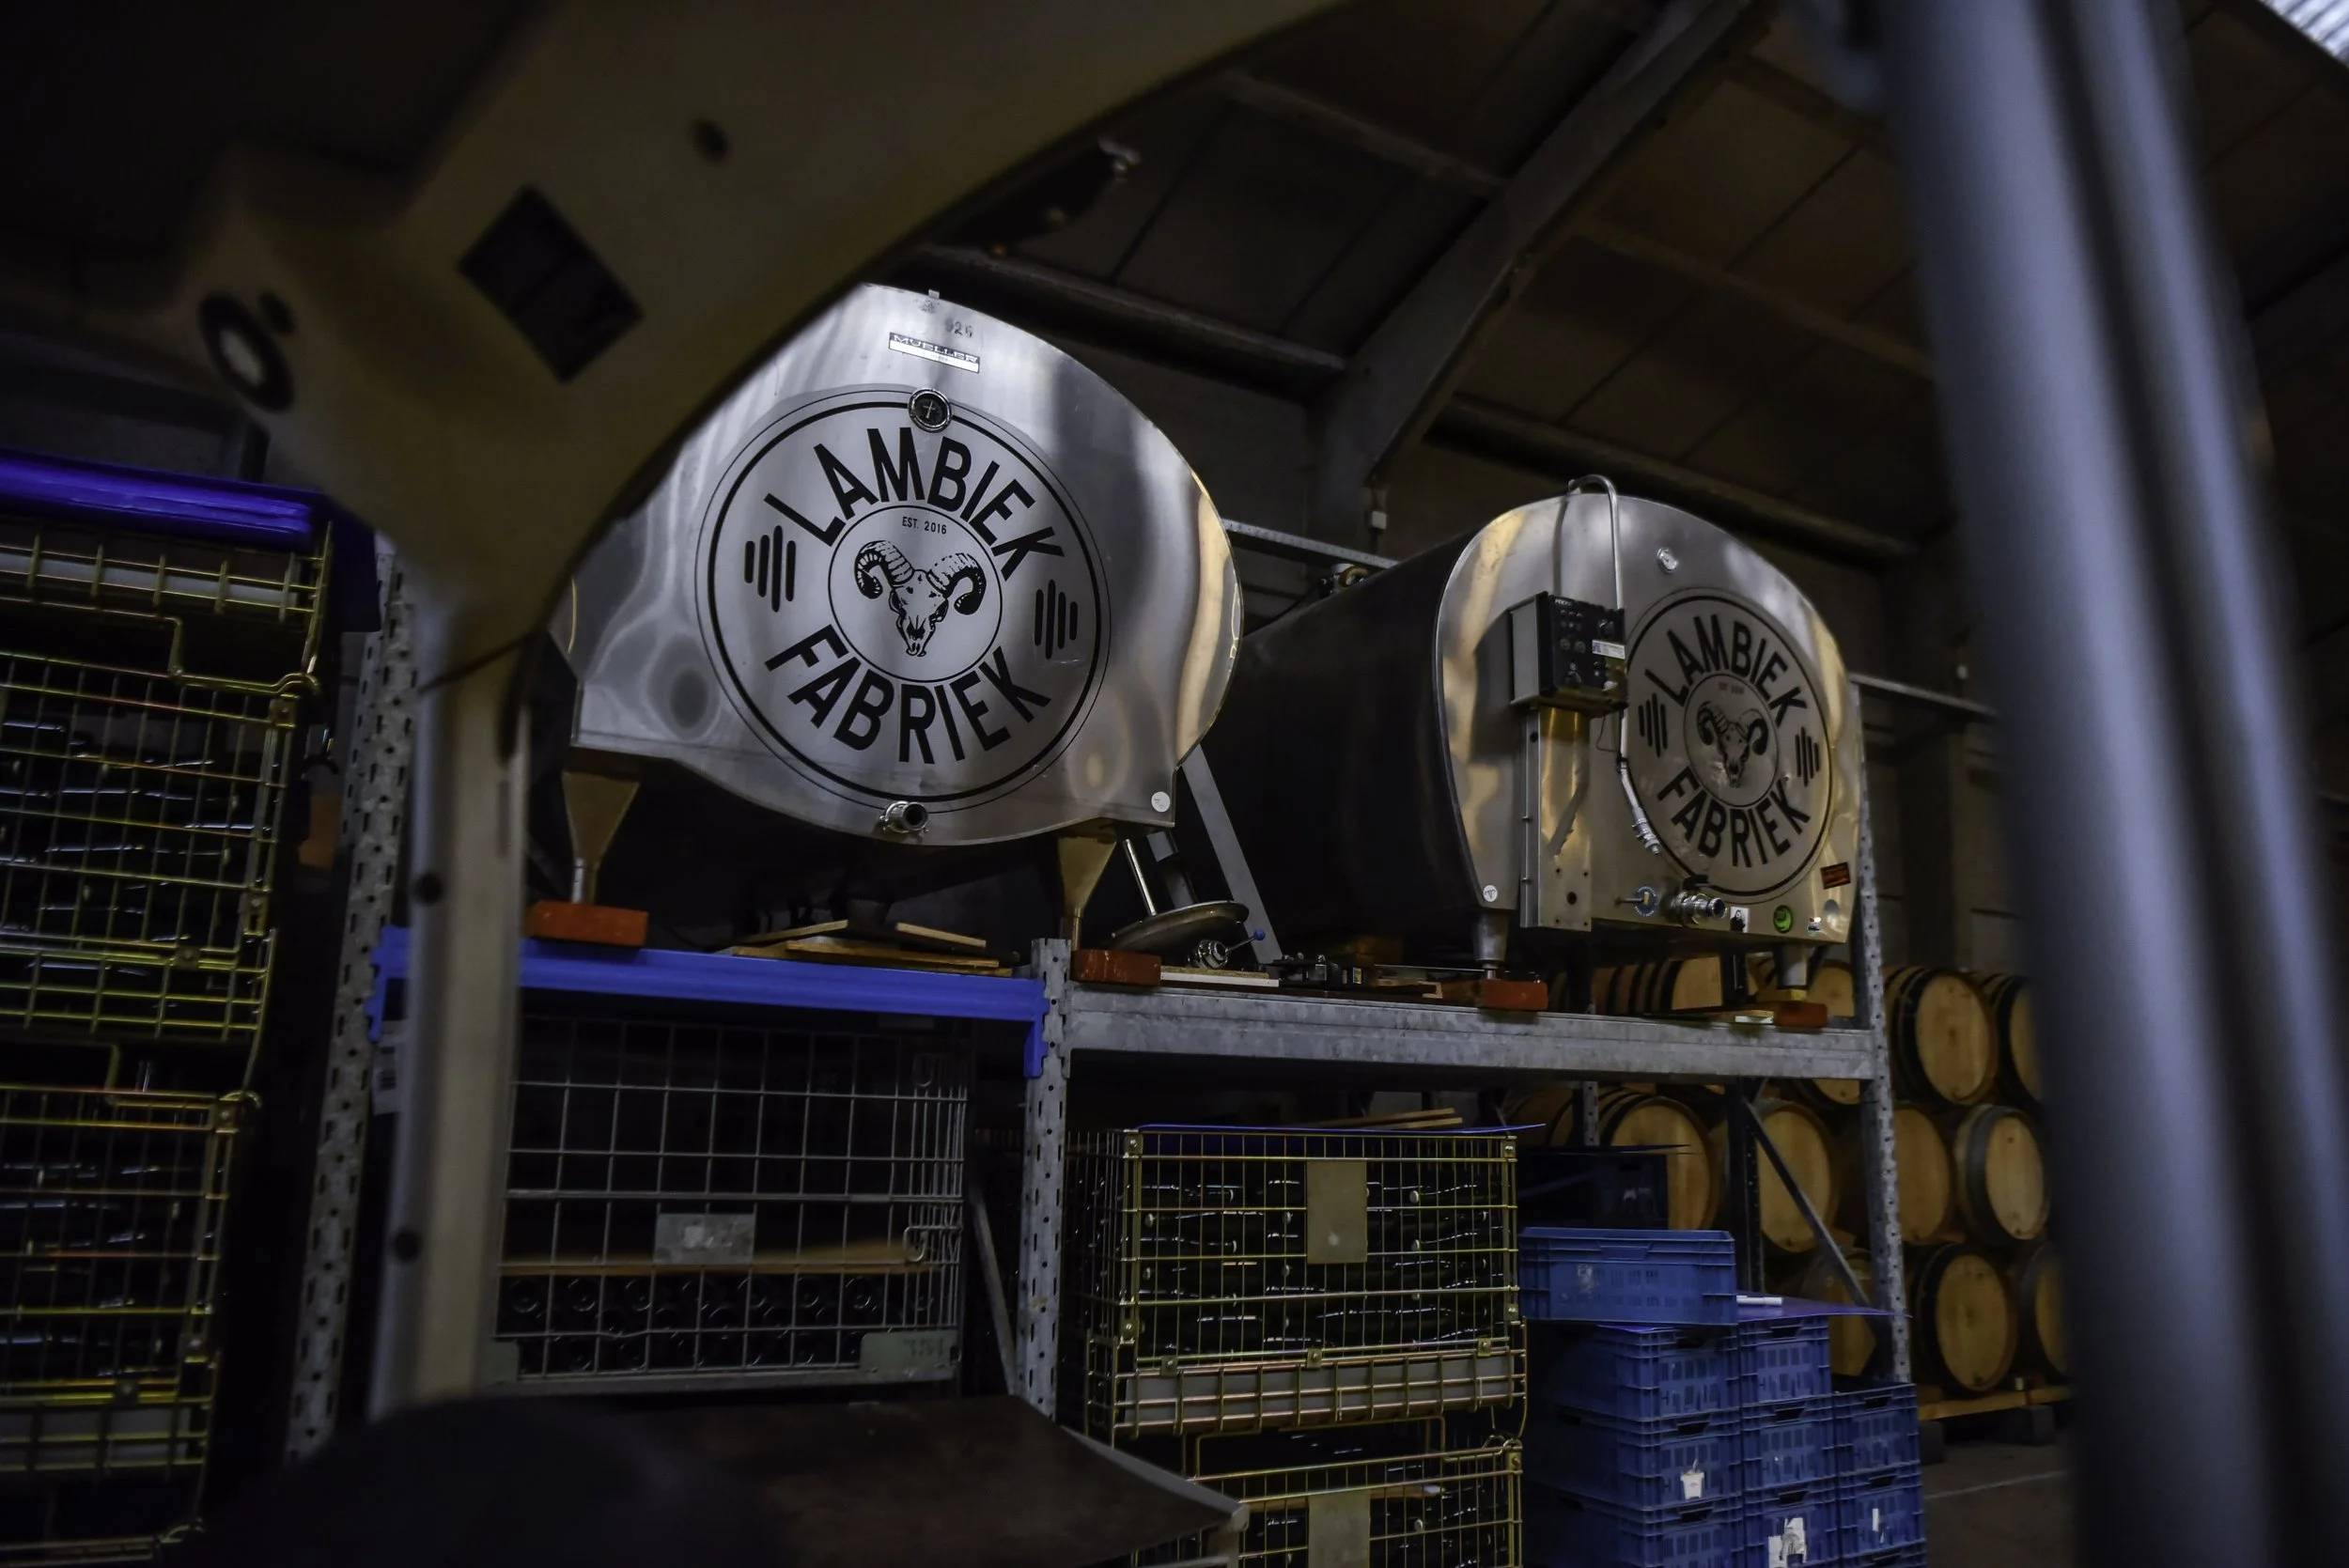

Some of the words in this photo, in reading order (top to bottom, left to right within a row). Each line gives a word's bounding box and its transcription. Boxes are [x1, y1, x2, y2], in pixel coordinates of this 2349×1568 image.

[893, 334, 979, 364] MUELLER
[764, 427, 1065, 582] LAMBIEK
[902, 516, 919, 529] EST.
[924, 520, 947, 535] 2016
[765, 624, 1051, 765] FABRIEK
[1645, 613, 1808, 728] LAMBIEK
[1657, 765, 1811, 868] FABRIEK
